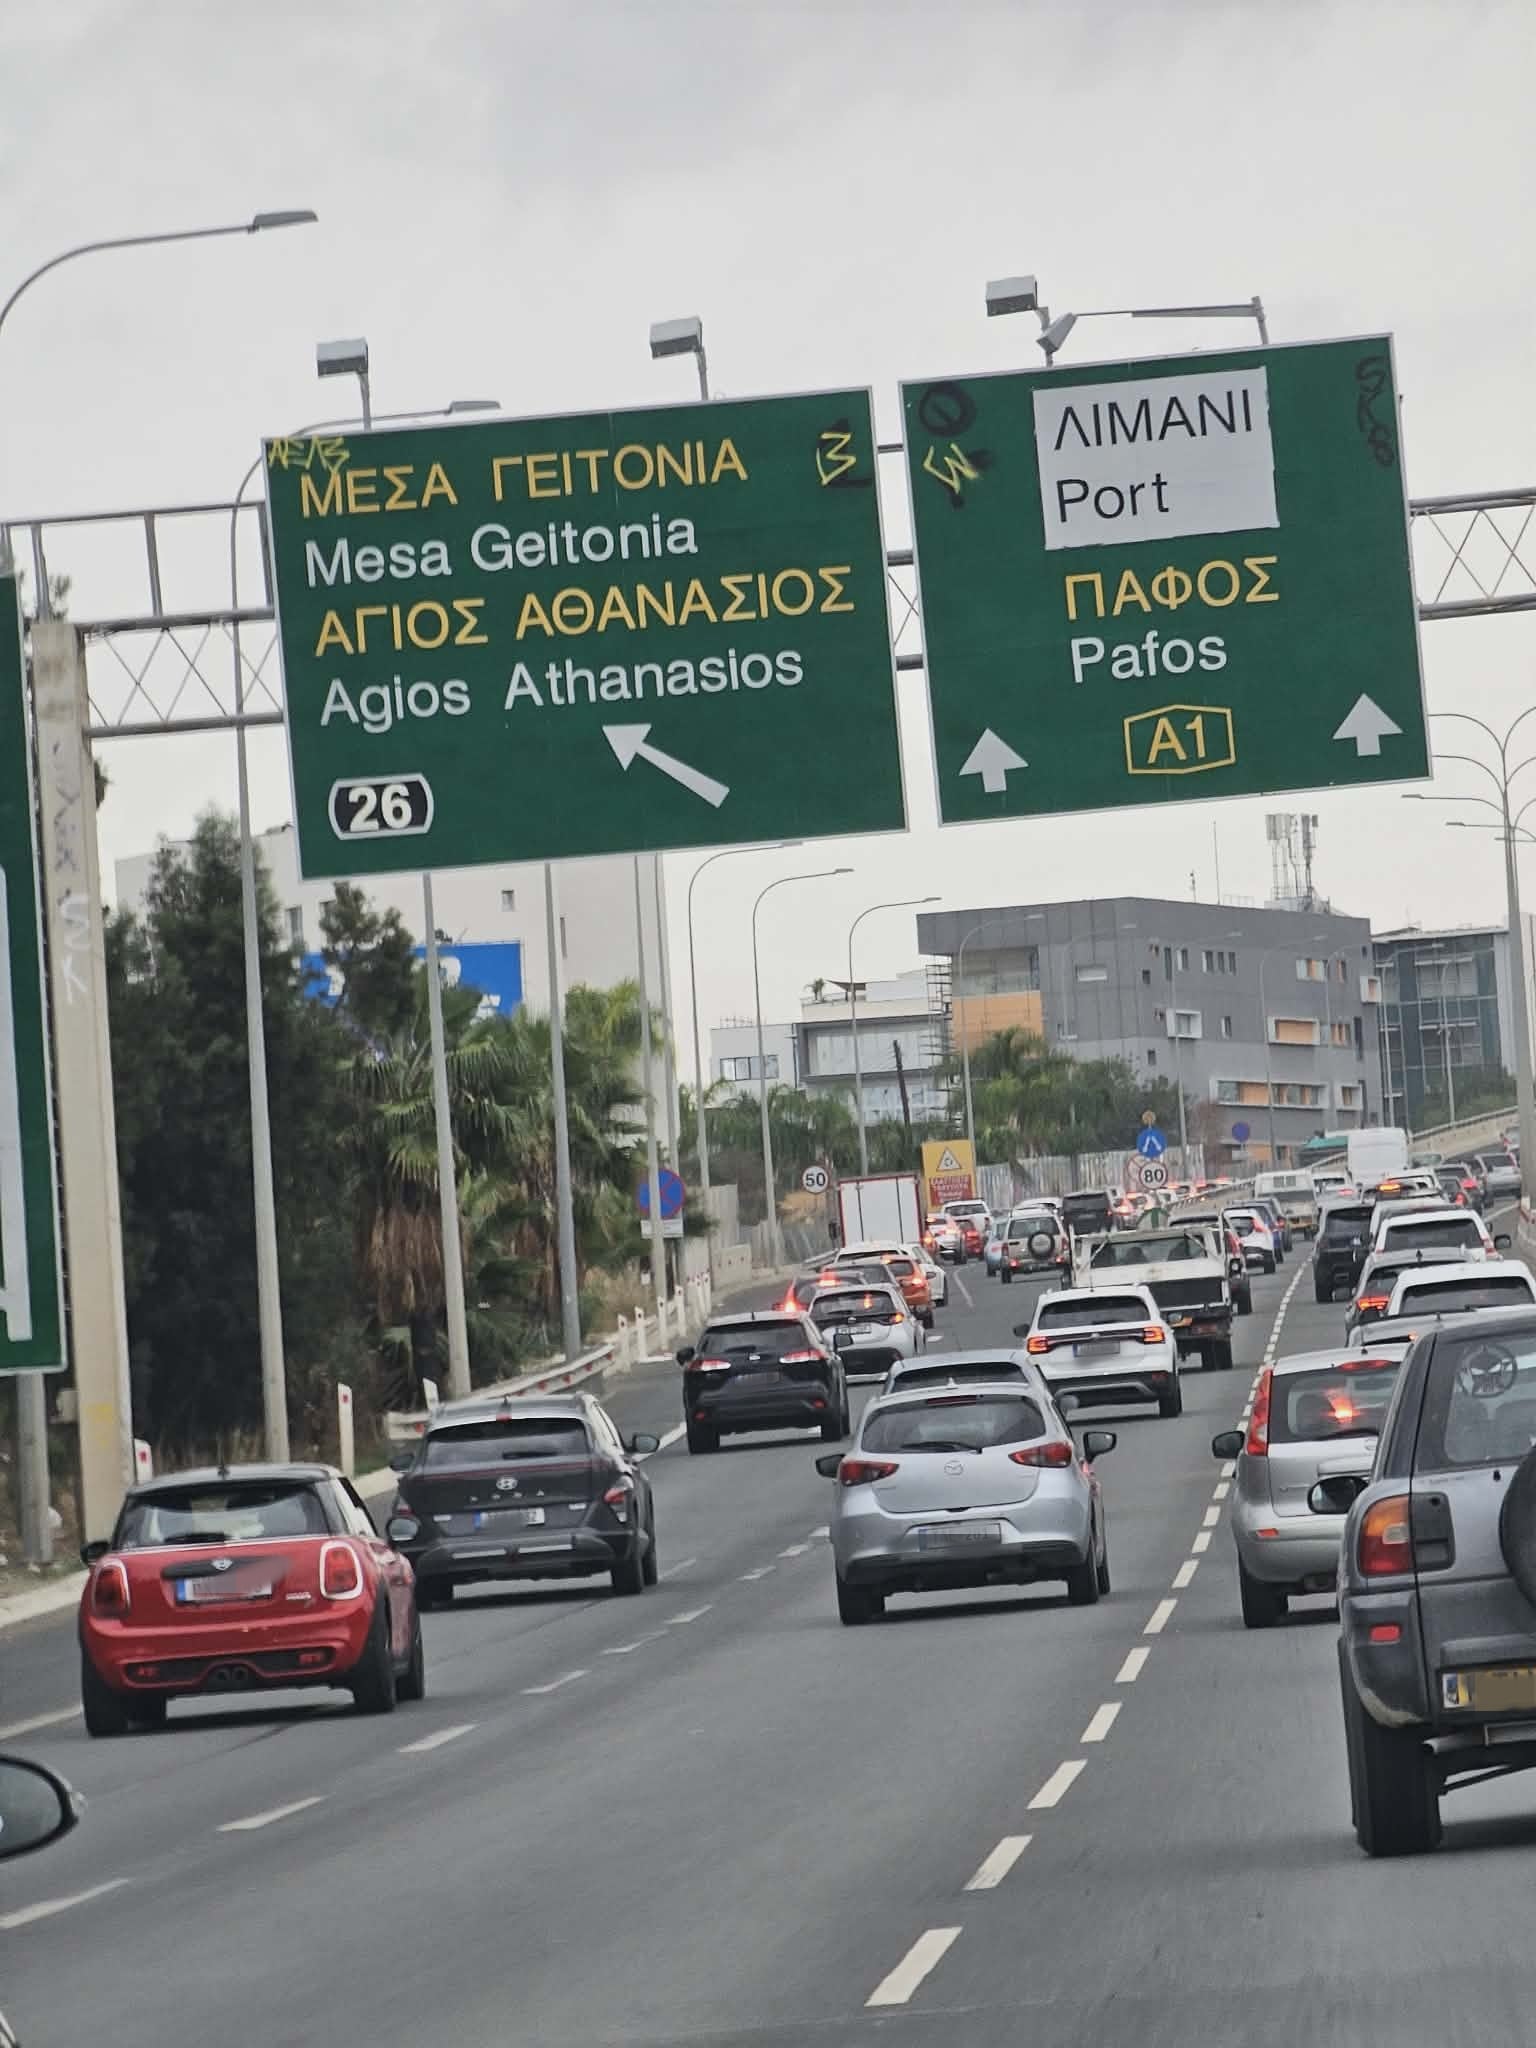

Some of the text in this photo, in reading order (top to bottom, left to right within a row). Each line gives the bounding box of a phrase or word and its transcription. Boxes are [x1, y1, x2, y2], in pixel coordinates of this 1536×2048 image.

[1054, 389, 1252, 451] ΛΙΜΑΝΙ
[301, 438, 748, 518] ΜΕΣΑ ΓΕΙΤΟΝΙΑ
[1056, 472, 1170, 523] Port
[305, 513, 699, 587] Mesa Geitonia
[315, 565, 856, 657] ΑΓΙΟΣ ΑΘΑΝΑΣΙΟΣ
[1065, 555, 1280, 620] ΠΑΦΟΣ
[1071, 630, 1228, 683] Pafos
[320, 647, 804, 734] Agios Athanasios
[1147, 714, 1207, 764] A1
[347, 785, 413, 833] 26
[806, 1172, 826, 1187] 50
[1144, 1169, 1164, 1183] 80
